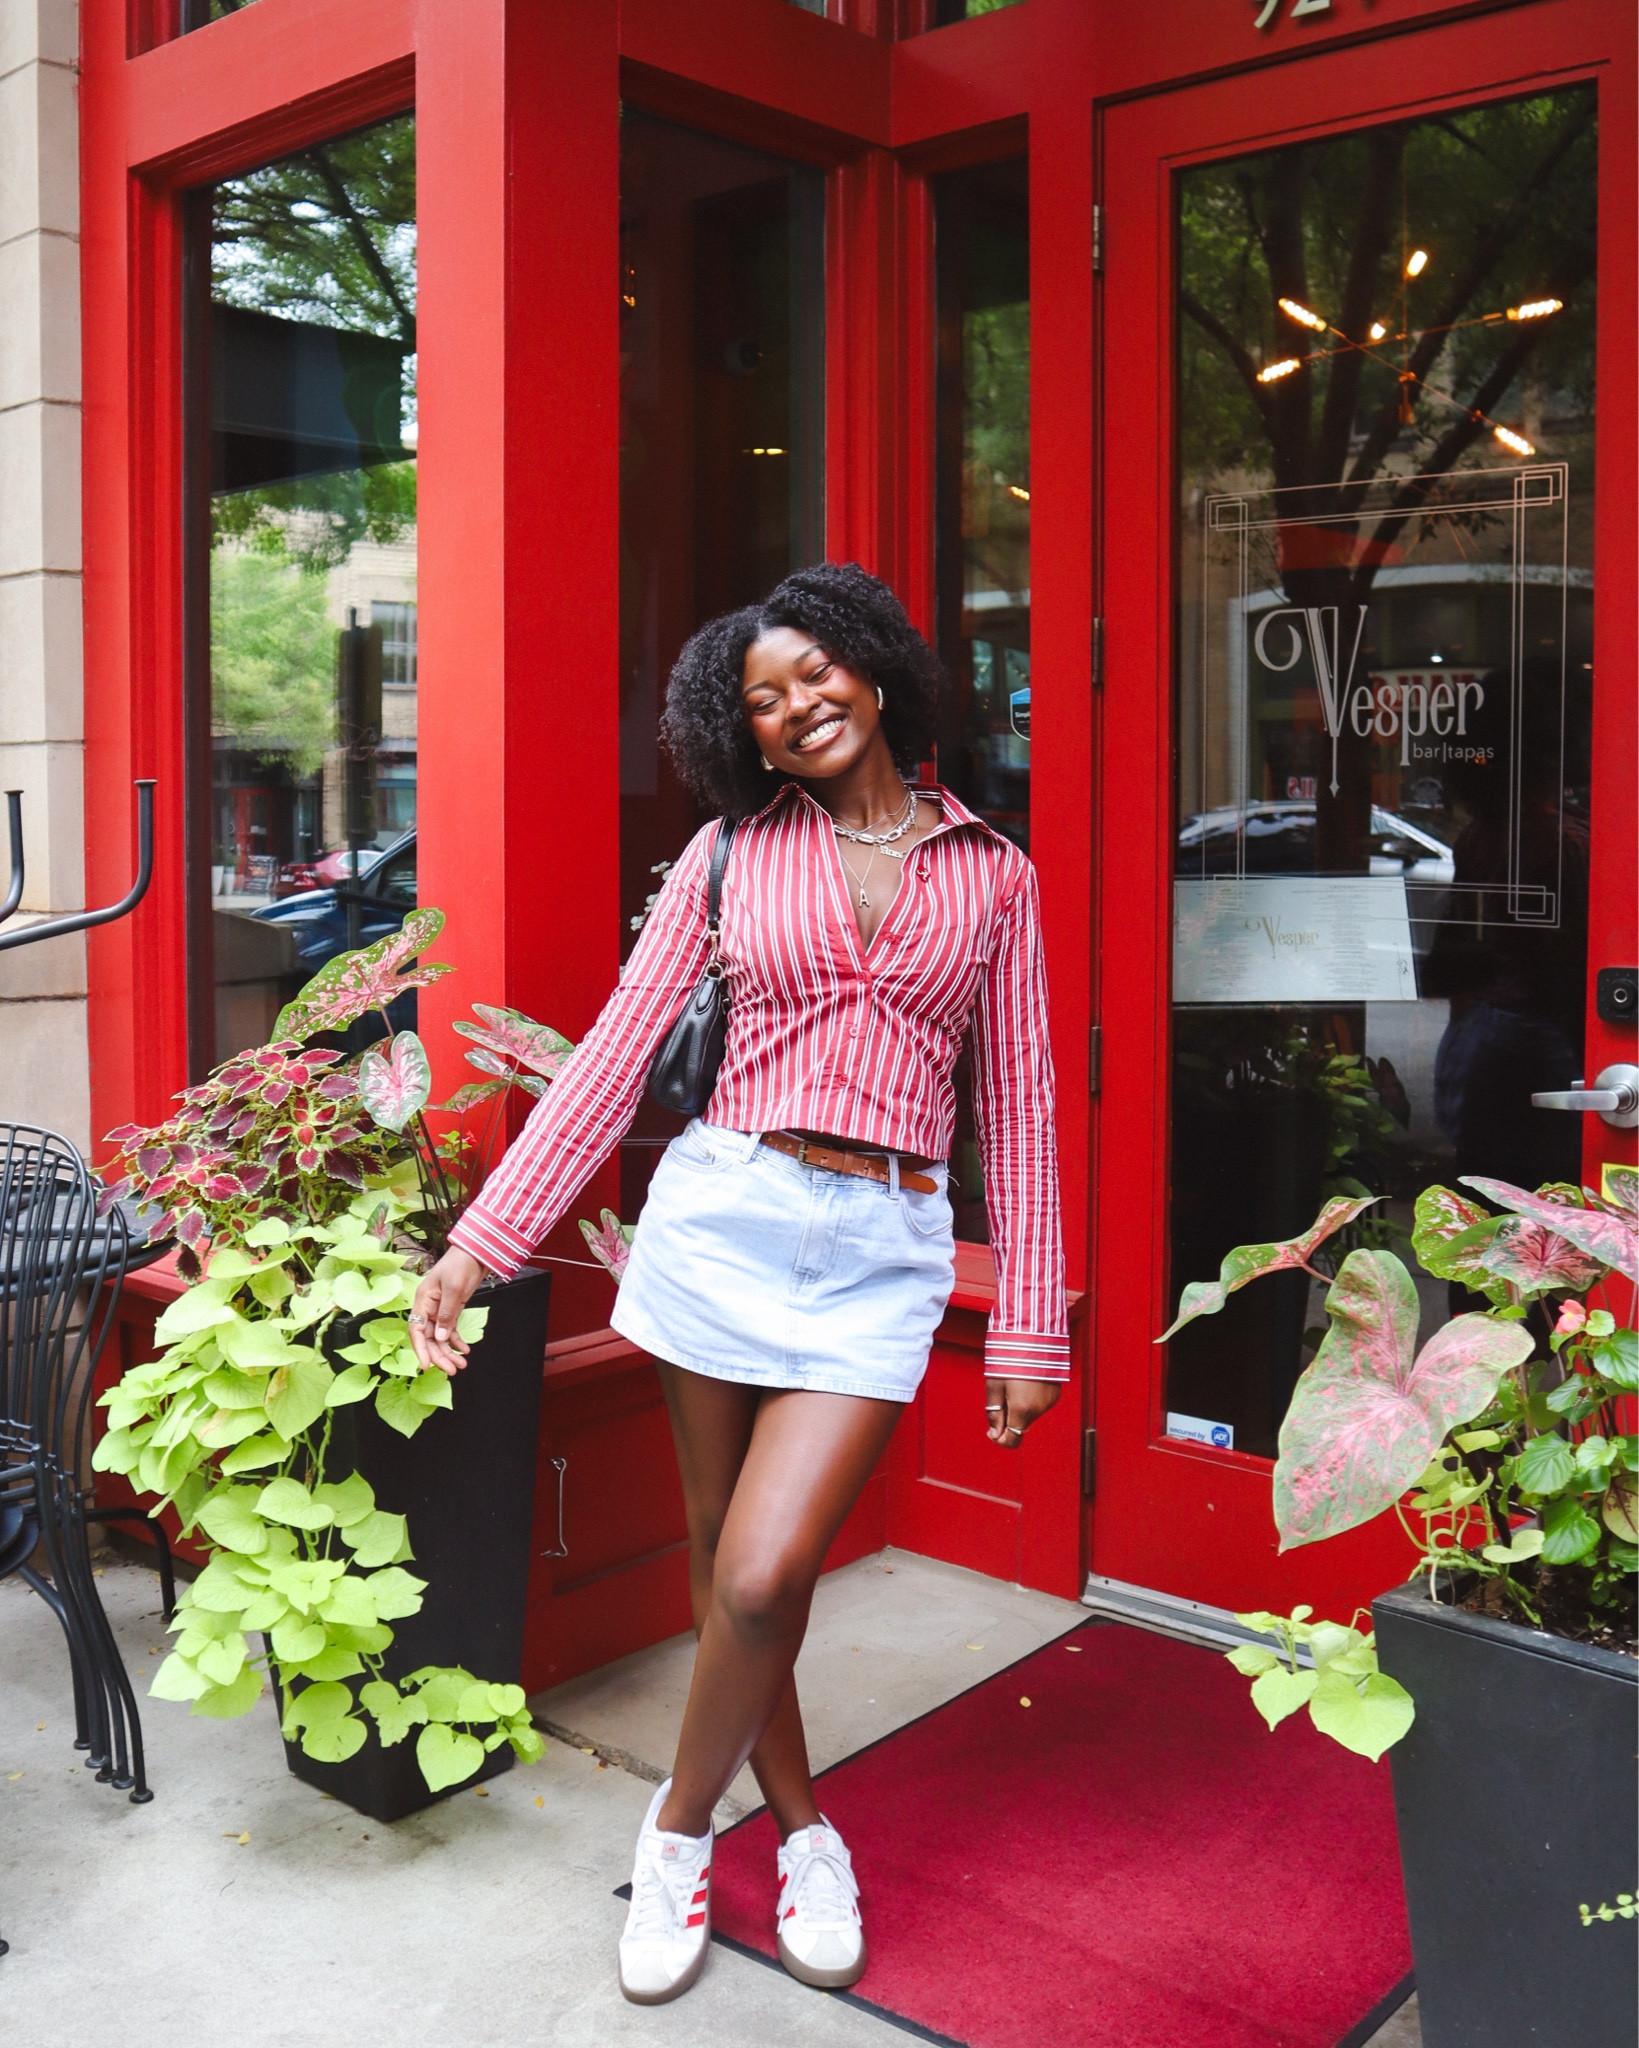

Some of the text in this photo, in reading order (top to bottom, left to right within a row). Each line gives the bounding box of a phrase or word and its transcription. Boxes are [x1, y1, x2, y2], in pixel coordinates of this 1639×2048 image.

[1254, 605, 1485, 797] Vesper
[859, 887, 870, 908] A
[1244, 915, 1319, 959] Vesper
[1169, 1427, 1206, 1441] secured by
[1213, 1430, 1228, 1443] ADT
